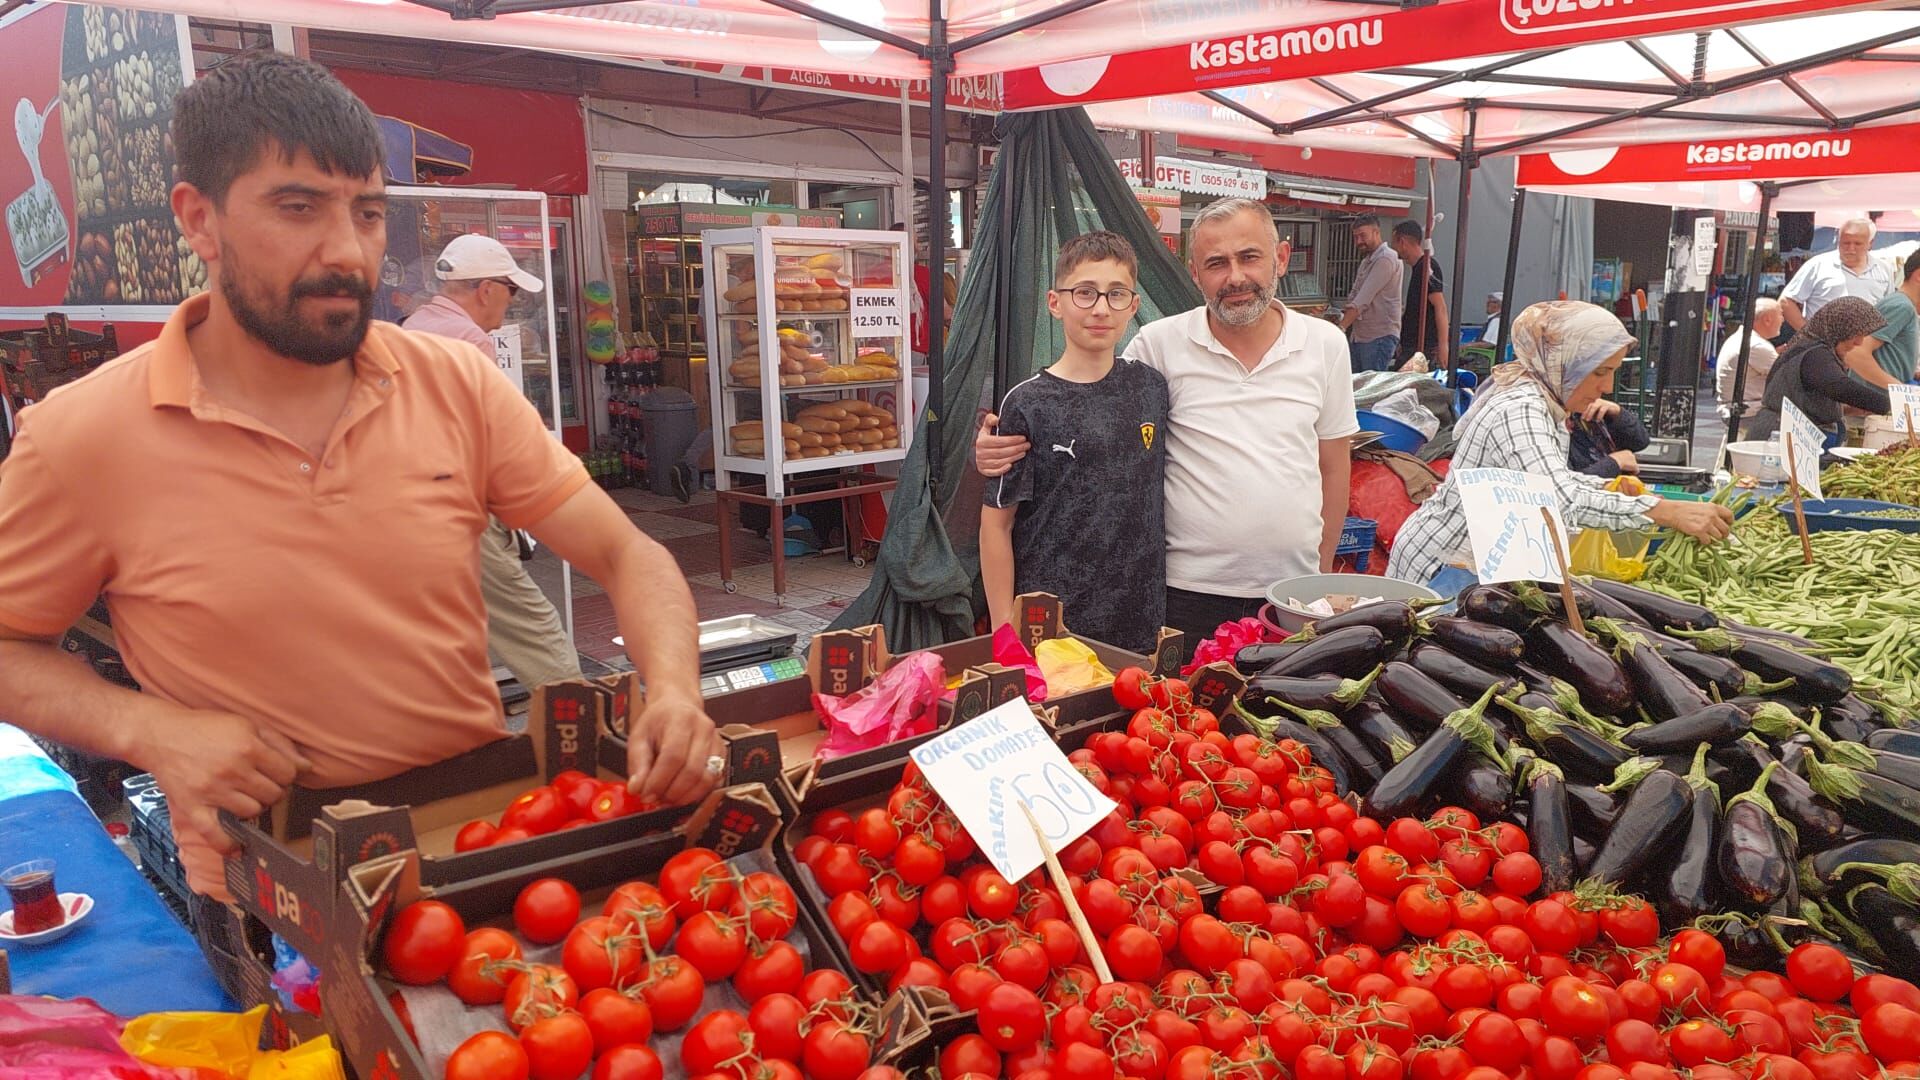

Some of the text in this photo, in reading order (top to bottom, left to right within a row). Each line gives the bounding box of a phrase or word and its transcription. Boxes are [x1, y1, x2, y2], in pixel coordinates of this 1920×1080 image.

[1190, 19, 1383, 70] Kastamonu
[790, 70, 832, 87] ALGIDA
[1686, 139, 1852, 164] Kastamonu
[1156, 163, 1191, 184] ÖFTE
[856, 296, 896, 307] EKMEK
[854, 316, 900, 327] 12.50 TL
[963, 725, 1051, 771] DOMATES
[1010, 762, 1097, 840] 50
